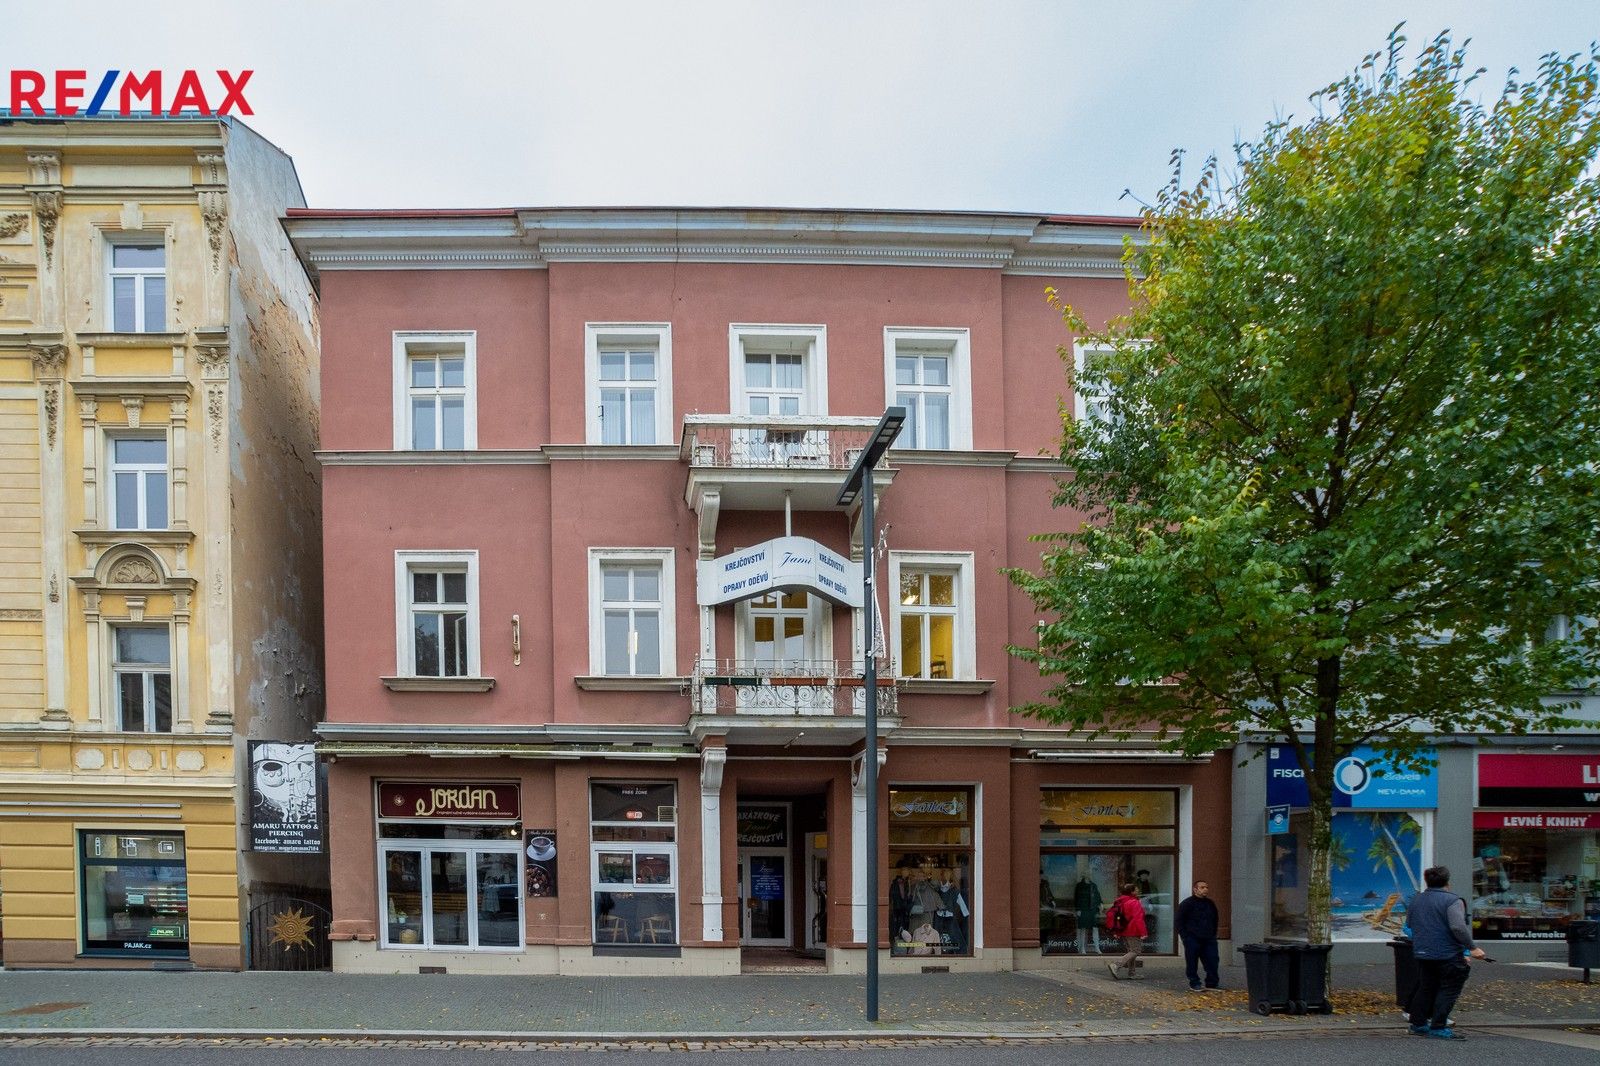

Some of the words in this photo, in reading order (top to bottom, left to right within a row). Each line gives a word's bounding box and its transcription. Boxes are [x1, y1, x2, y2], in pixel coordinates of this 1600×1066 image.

[724, 549, 765, 572] KREJČOVSTVÍ
[819, 552, 845, 574] KREJČOVSTVÍ
[723, 580, 747, 594] OPRAVY
[748, 570, 769, 587] ODĚVŮ
[818, 574, 834, 589] OPRAVY
[1503, 814, 1543, 827] LEVNÉ
[1546, 816, 1588, 827] KNIHY
[268, 830, 304, 838] PIERCING
